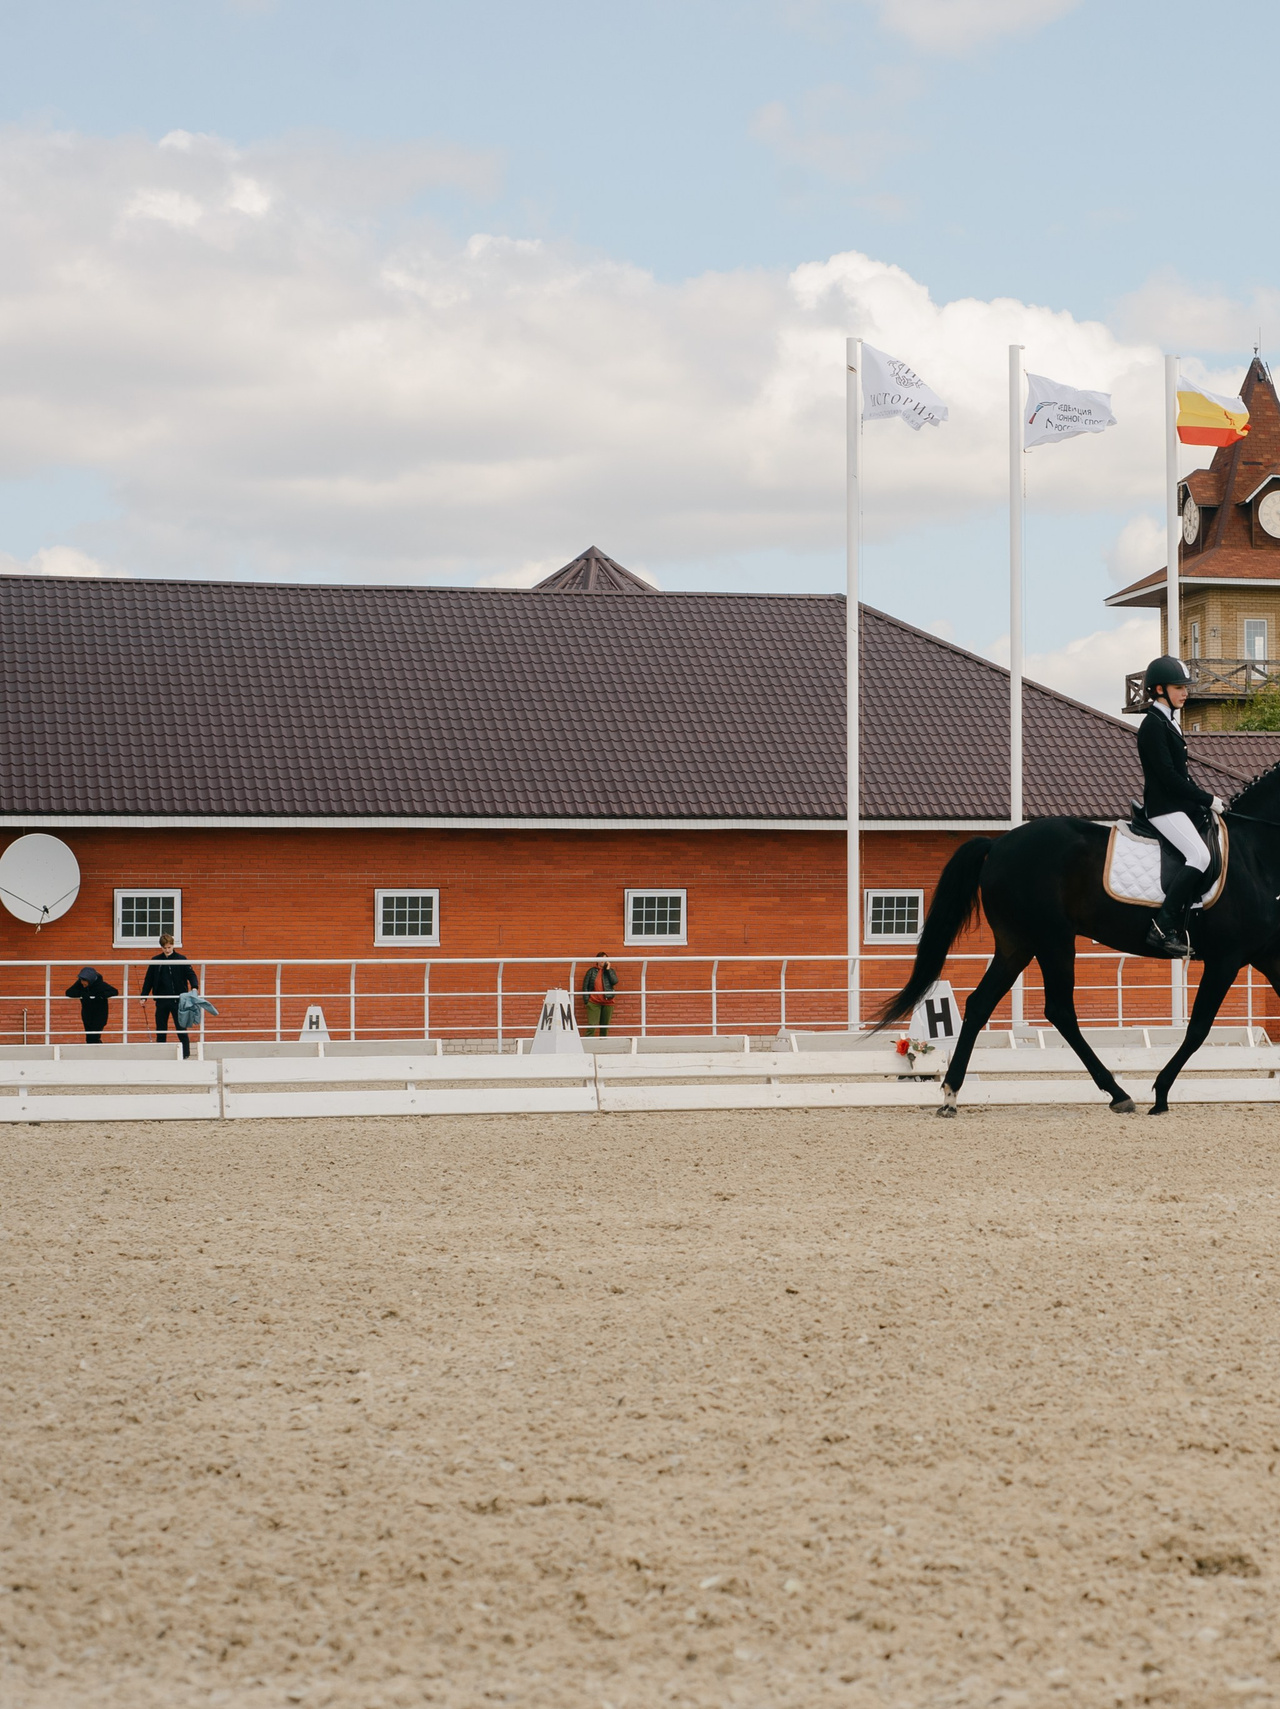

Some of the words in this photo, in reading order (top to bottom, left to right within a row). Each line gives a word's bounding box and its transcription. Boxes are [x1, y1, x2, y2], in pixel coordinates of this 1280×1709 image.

[870, 392, 935, 421] ИСТОРИЯ
[1058, 404, 1092, 416] ЕДЕЦИЯ
[309, 1014, 320, 1030] H
[540, 1003, 555, 1031] M
[560, 1003, 574, 1031] M
[925, 997, 953, 1039] H
